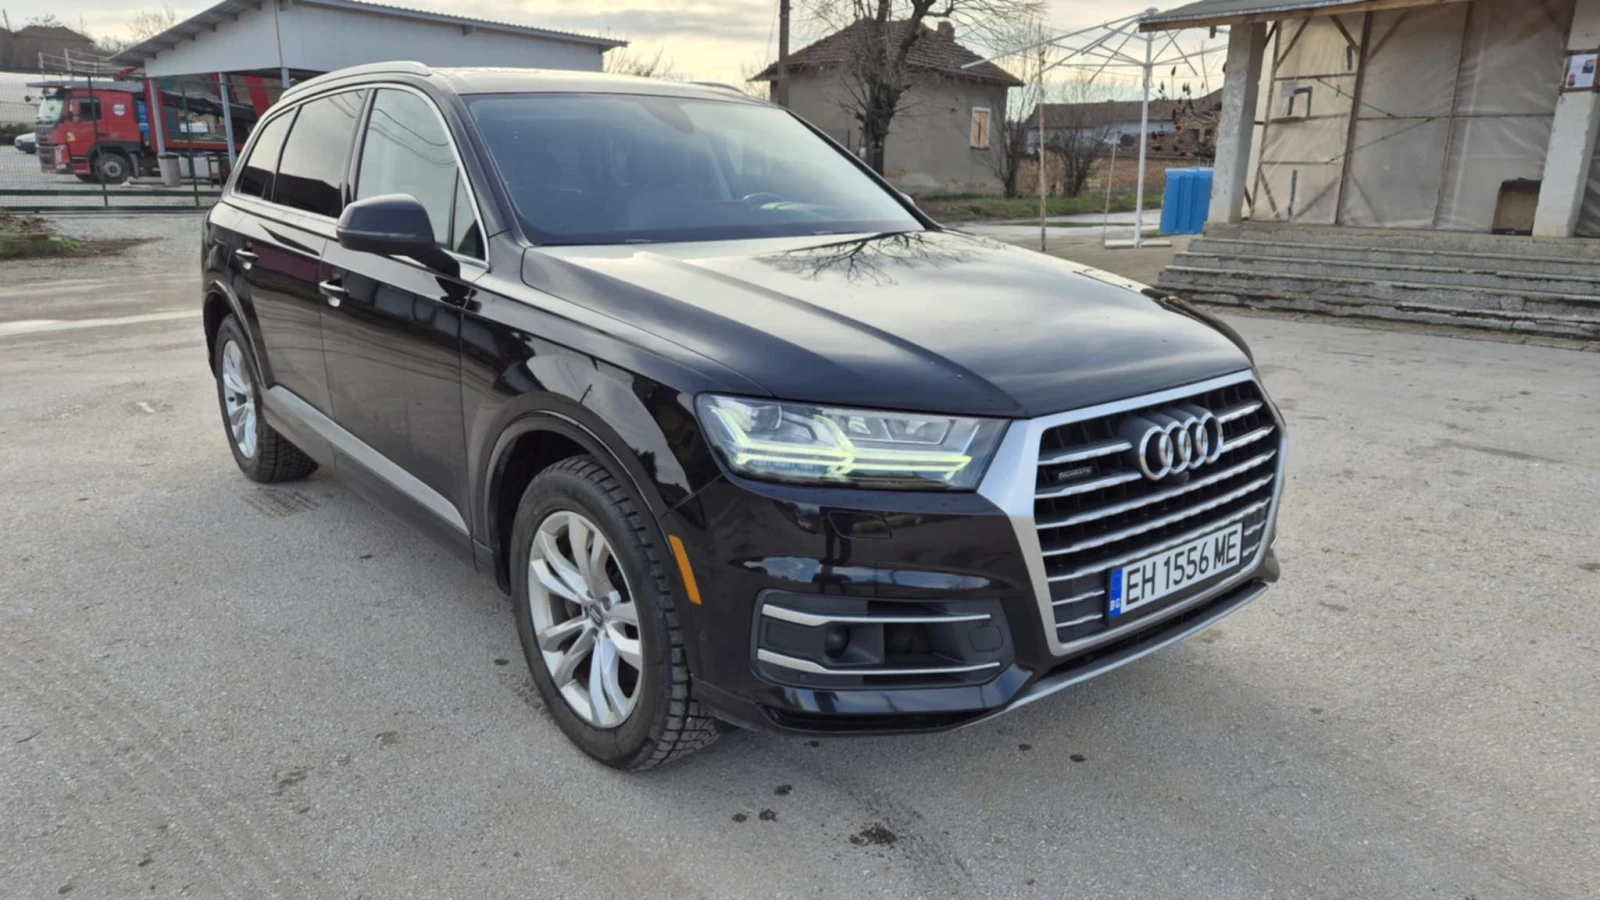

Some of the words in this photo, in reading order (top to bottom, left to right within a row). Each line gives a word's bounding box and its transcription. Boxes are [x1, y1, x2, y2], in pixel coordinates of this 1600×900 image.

[1126, 561, 1156, 605] EH
[1163, 542, 1209, 590] 1556
[1213, 530, 1239, 570] ME
[1110, 598, 1121, 611] BG
